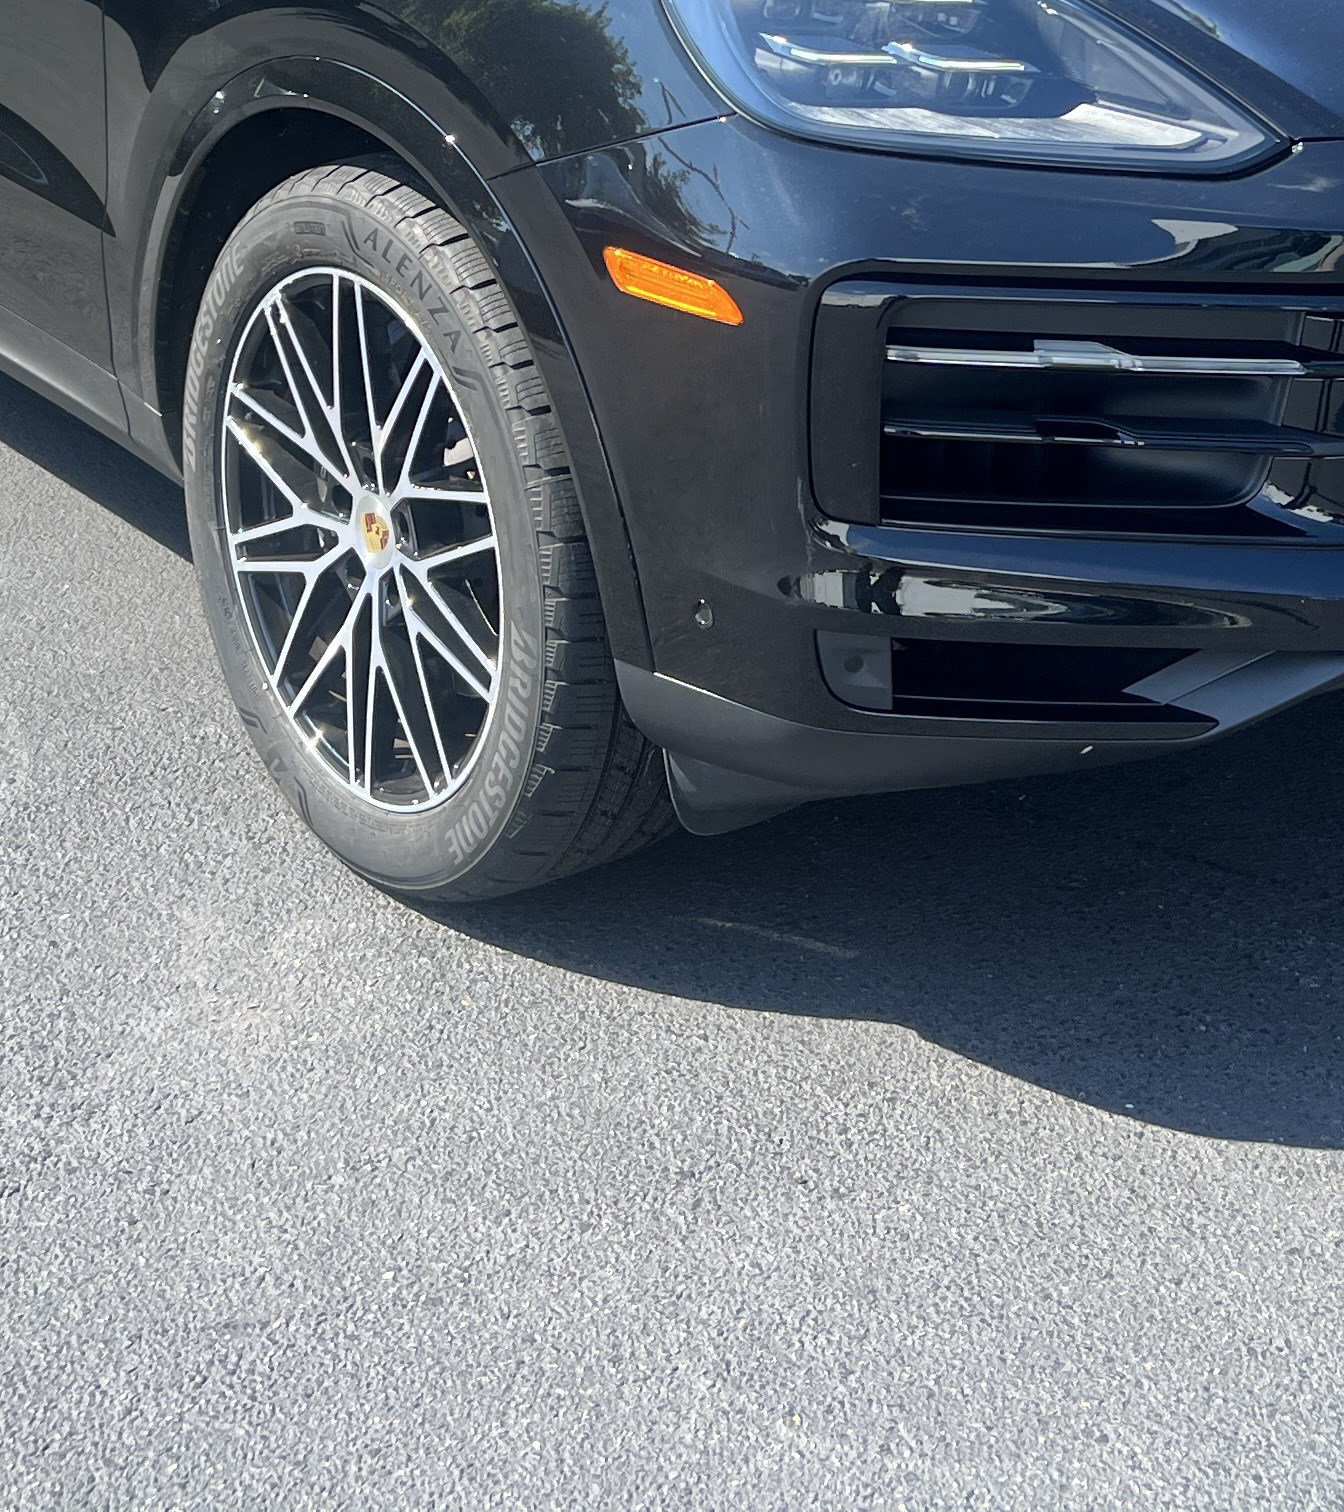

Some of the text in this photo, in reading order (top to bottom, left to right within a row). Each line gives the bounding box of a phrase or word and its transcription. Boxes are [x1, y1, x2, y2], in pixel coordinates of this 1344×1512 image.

[183, 241, 247, 472] BRIDGESTONE
[363, 227, 463, 355] ALENZA
[444, 620, 538, 865] BRIDGESTONE
